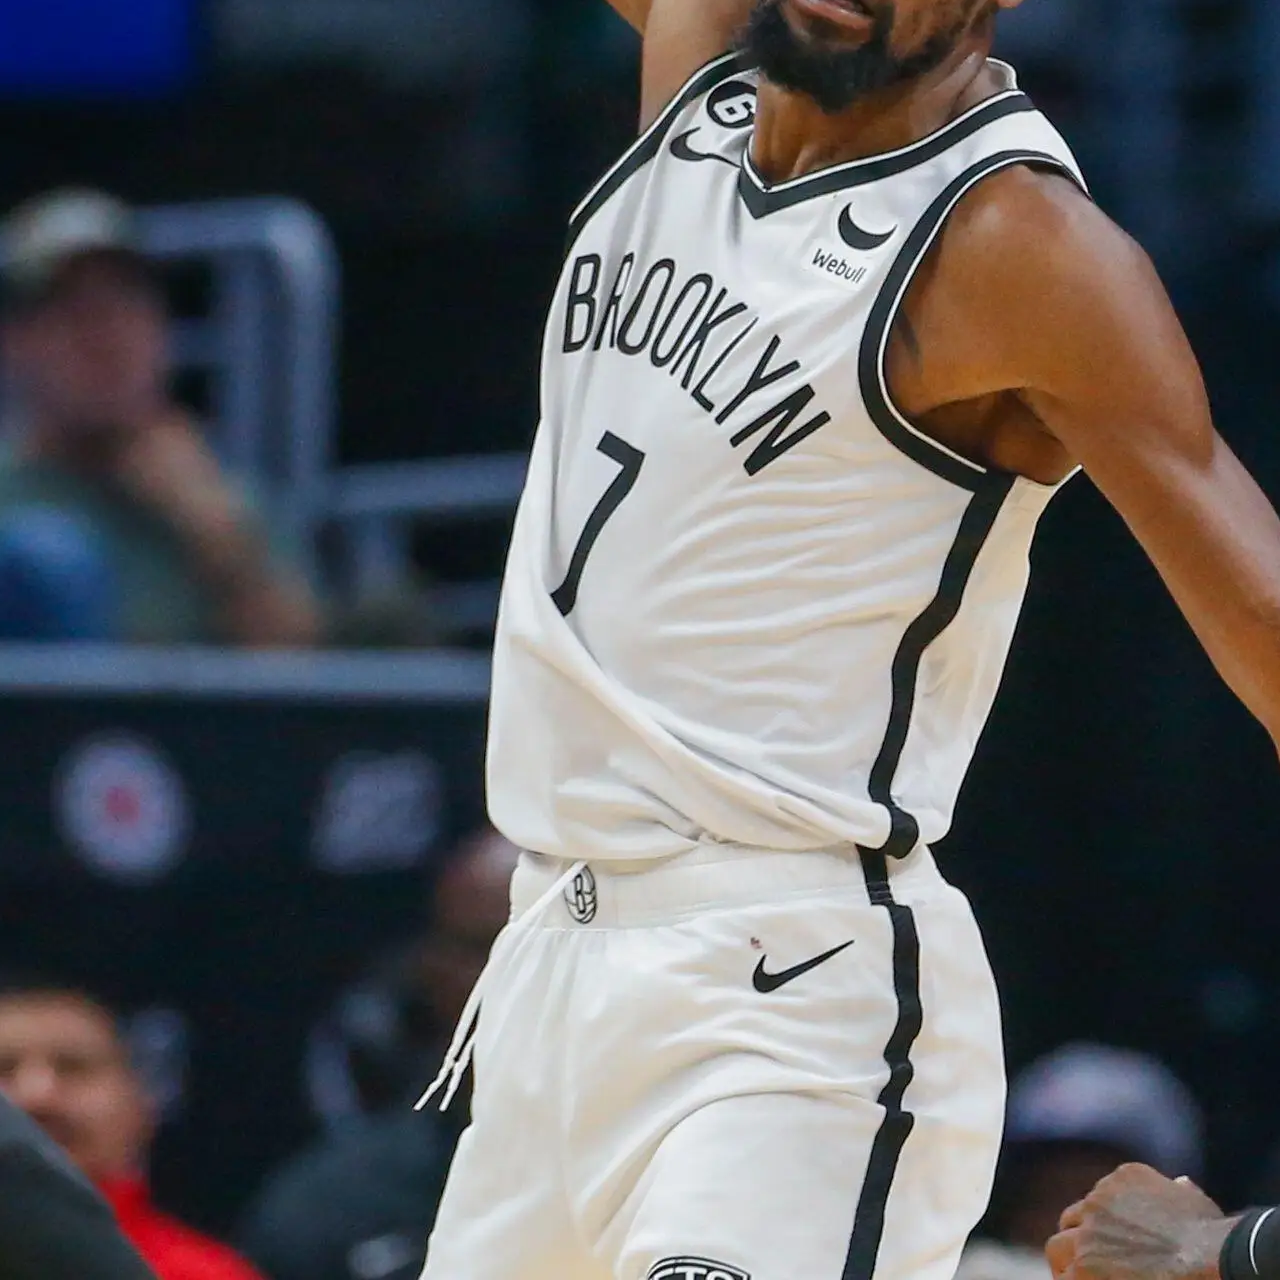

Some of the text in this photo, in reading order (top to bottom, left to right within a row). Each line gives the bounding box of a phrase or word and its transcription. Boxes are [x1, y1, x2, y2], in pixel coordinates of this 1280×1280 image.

[812, 248, 867, 284] Webull
[562, 252, 831, 477] BROOKLYN
[550, 429, 646, 618] 7
